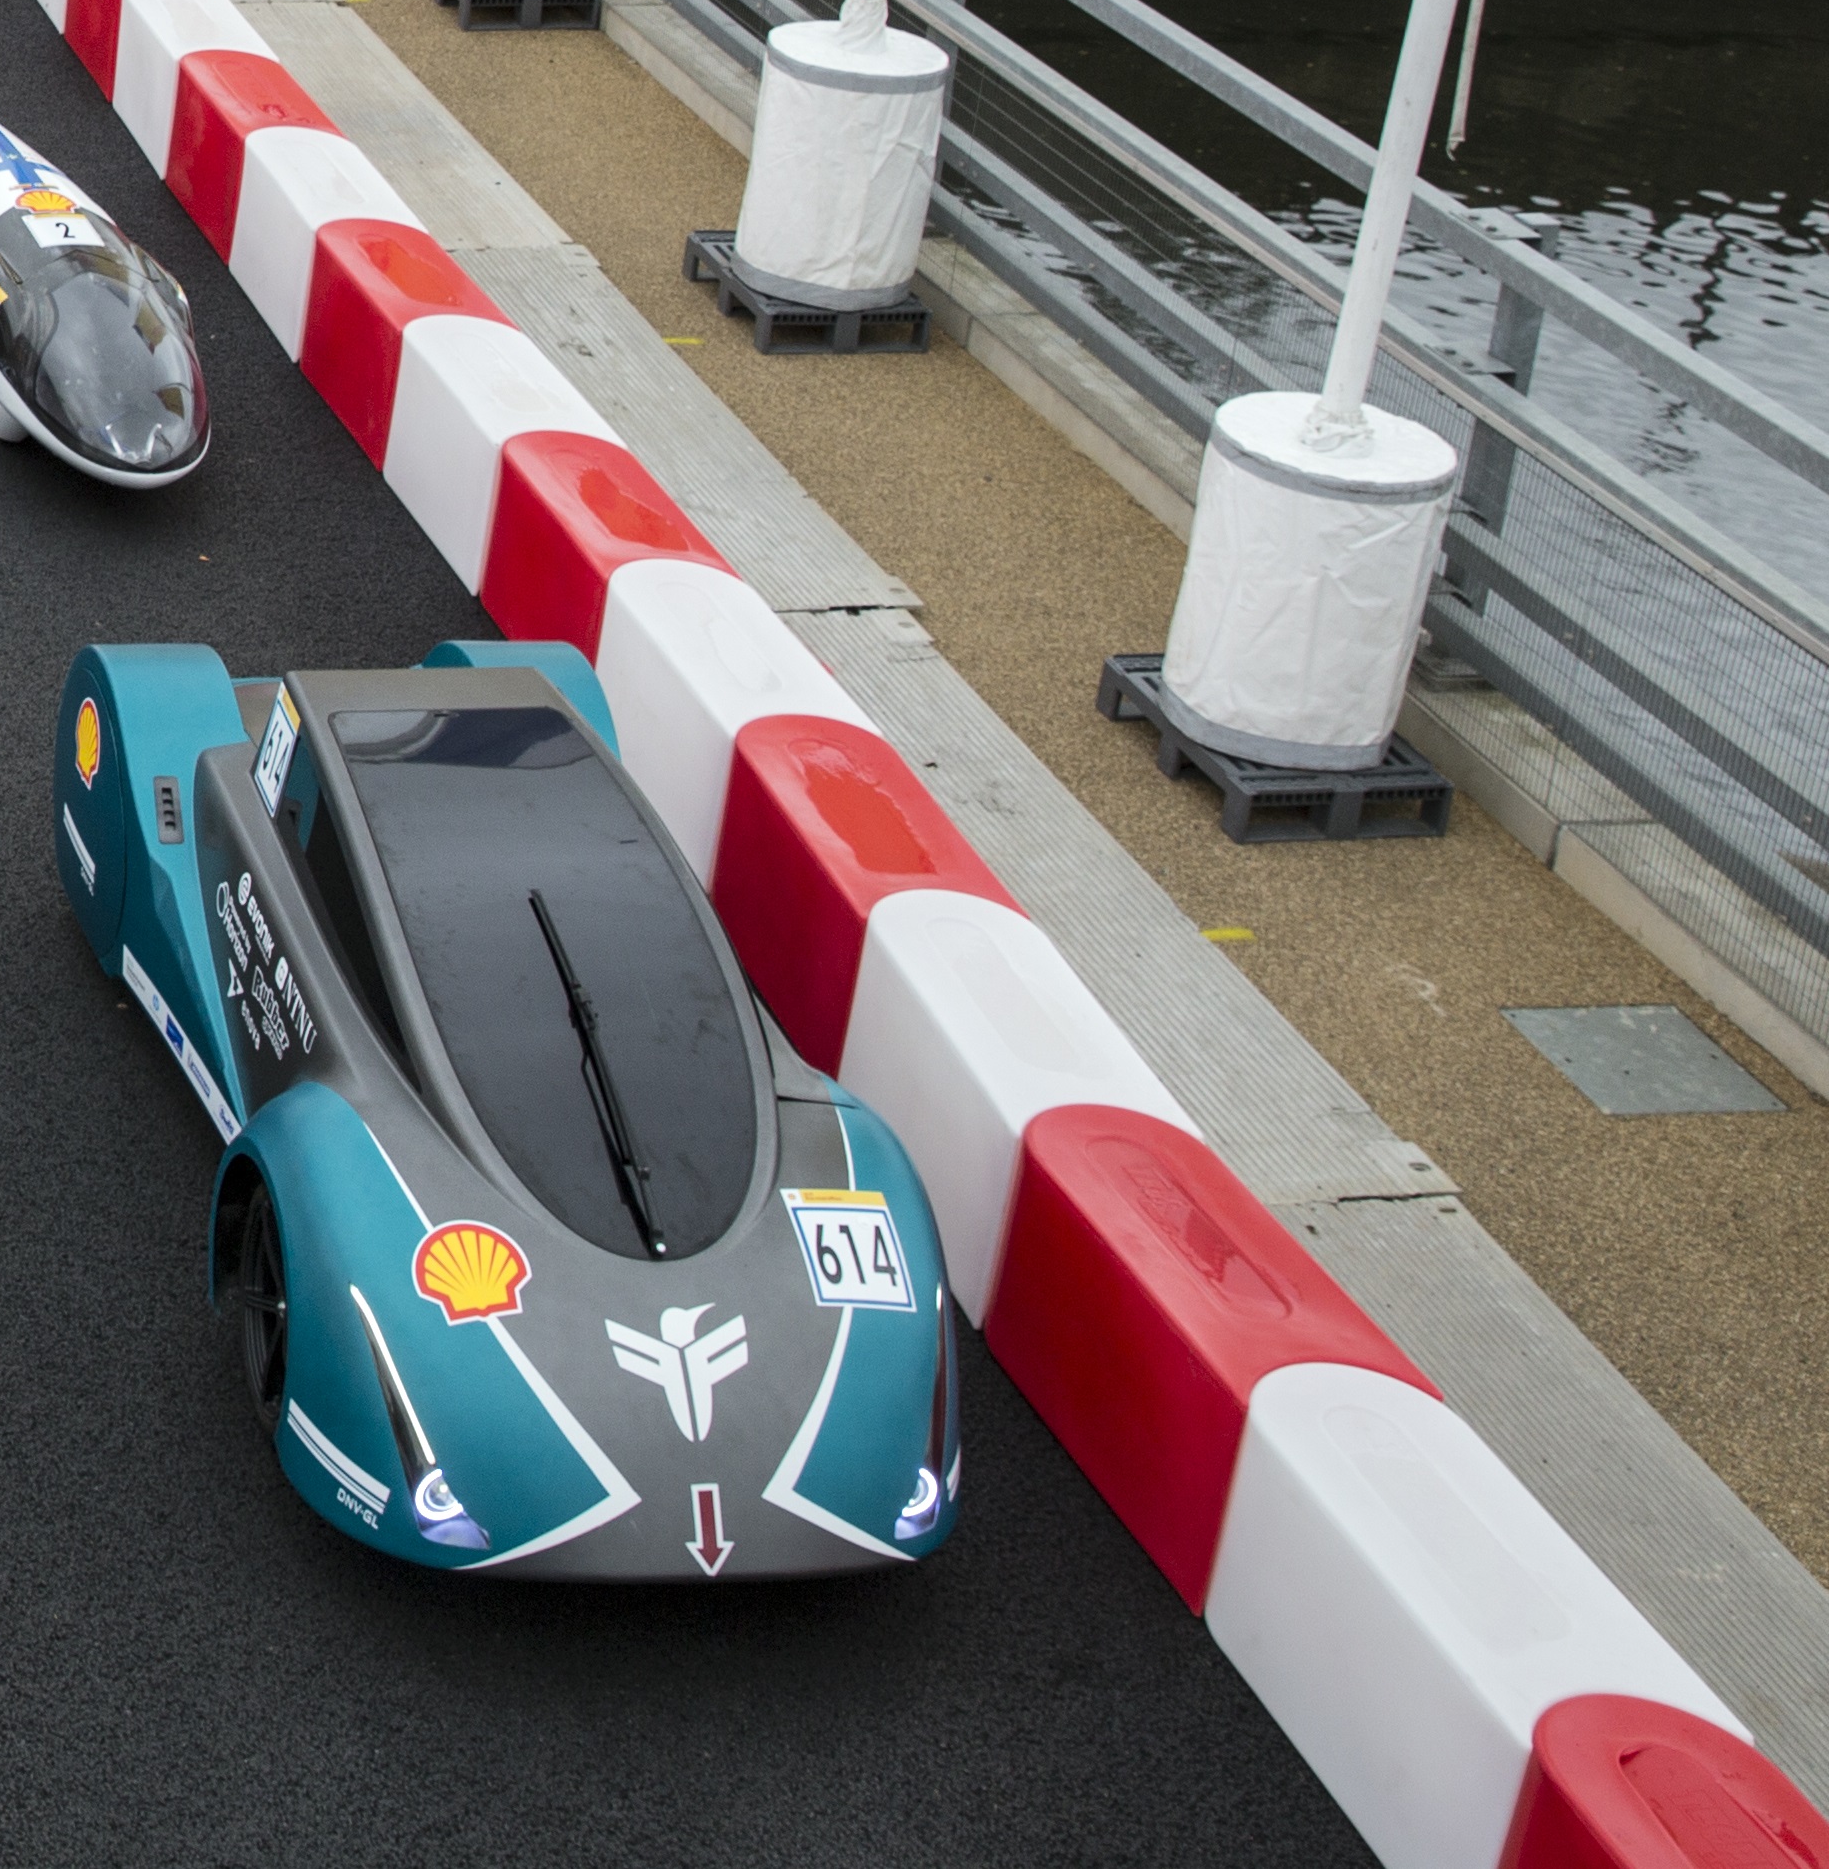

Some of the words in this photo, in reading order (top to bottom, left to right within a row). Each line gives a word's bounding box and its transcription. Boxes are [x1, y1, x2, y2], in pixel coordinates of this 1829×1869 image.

[56, 221, 75, 239] 2
[263, 721, 289, 793] 614
[282, 973, 317, 1054] NTNU
[816, 1224, 897, 1287] 614
